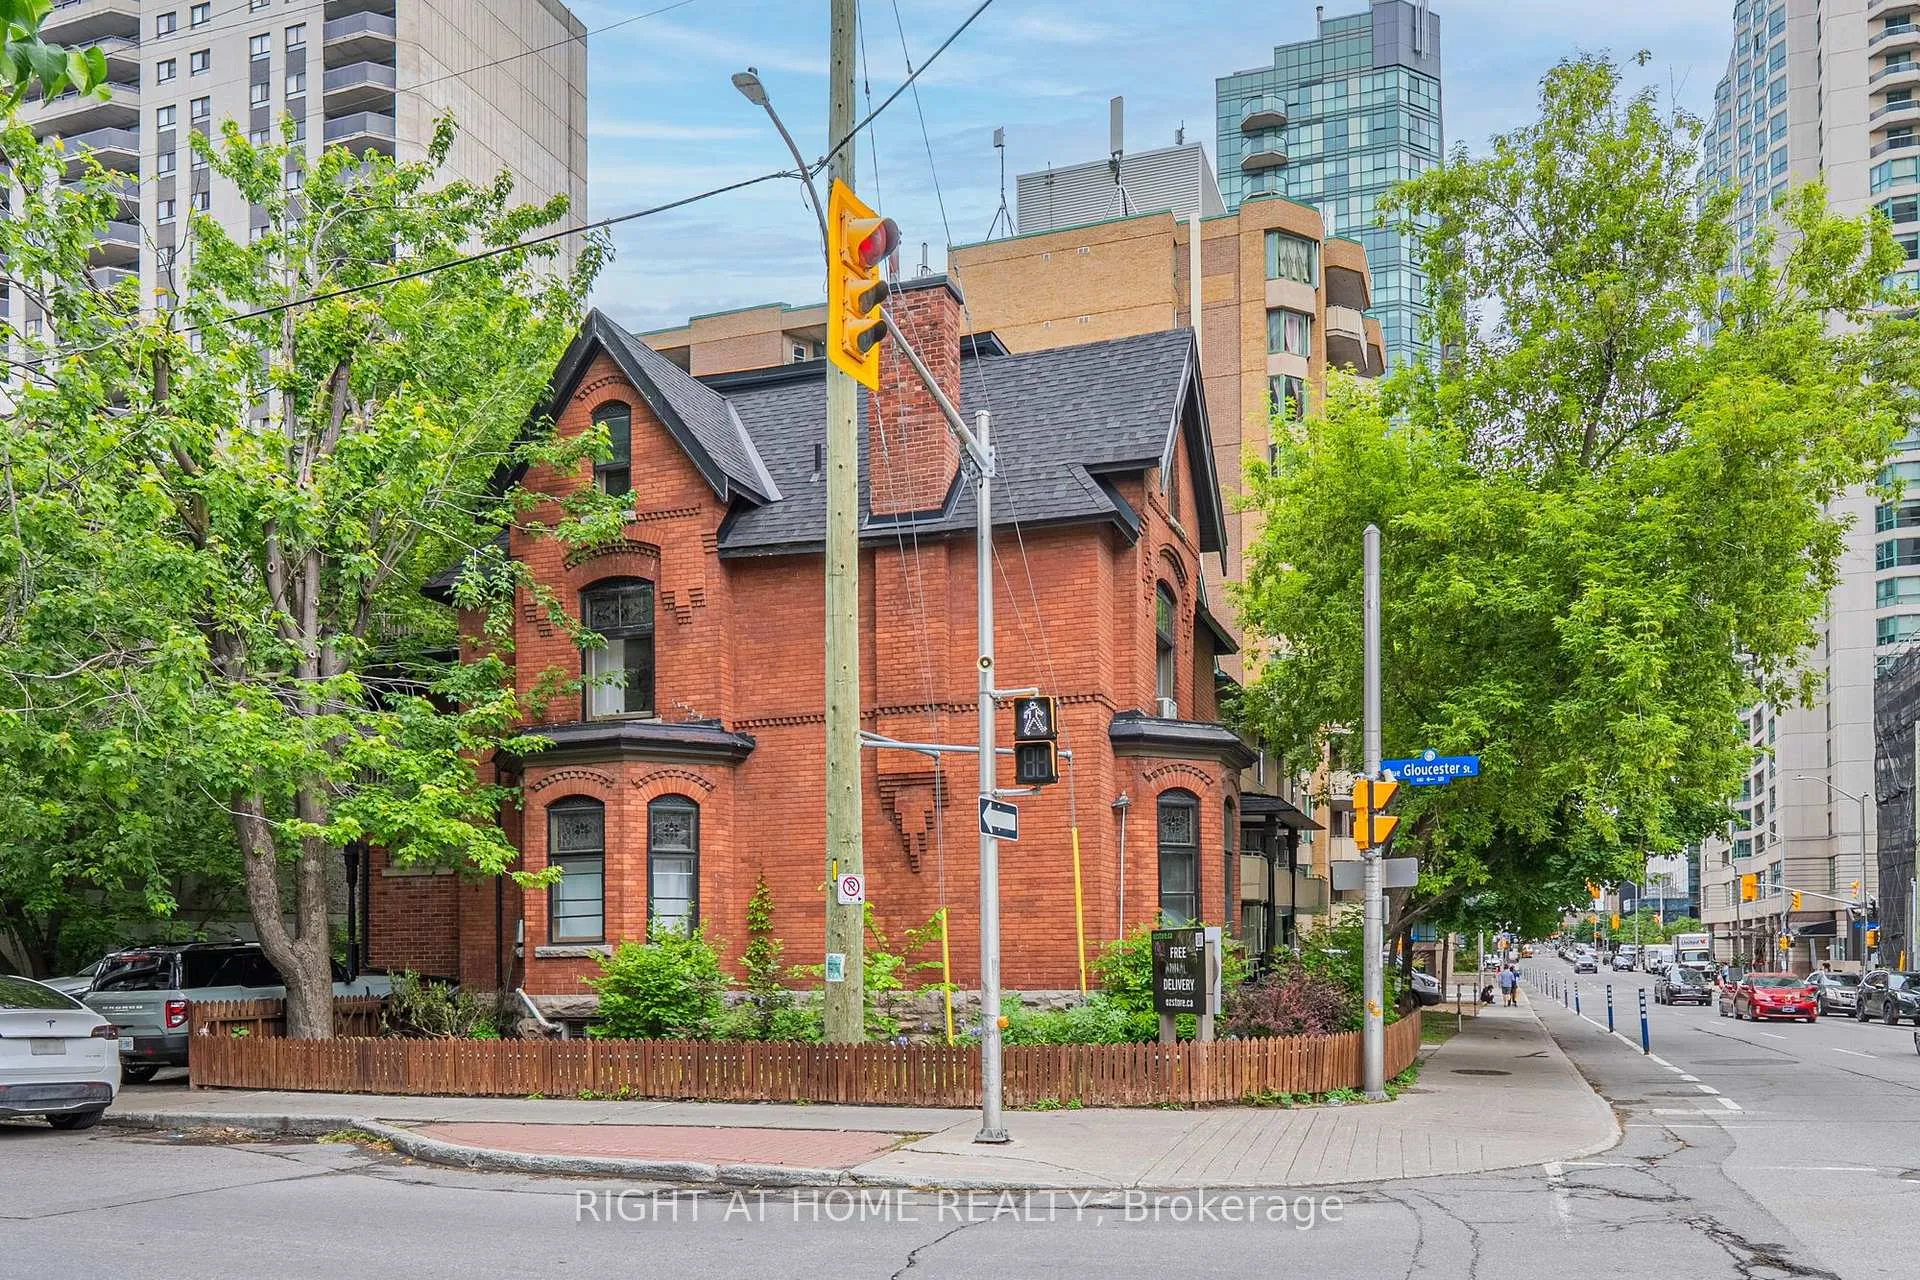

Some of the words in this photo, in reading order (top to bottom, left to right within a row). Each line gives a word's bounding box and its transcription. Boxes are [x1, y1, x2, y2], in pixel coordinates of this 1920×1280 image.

[1403, 762, 1460, 776] Gloucester
[1463, 765, 1473, 774] St.
[1169, 946, 1187, 959] FREE
[1163, 978, 1195, 991] DELIVERY
